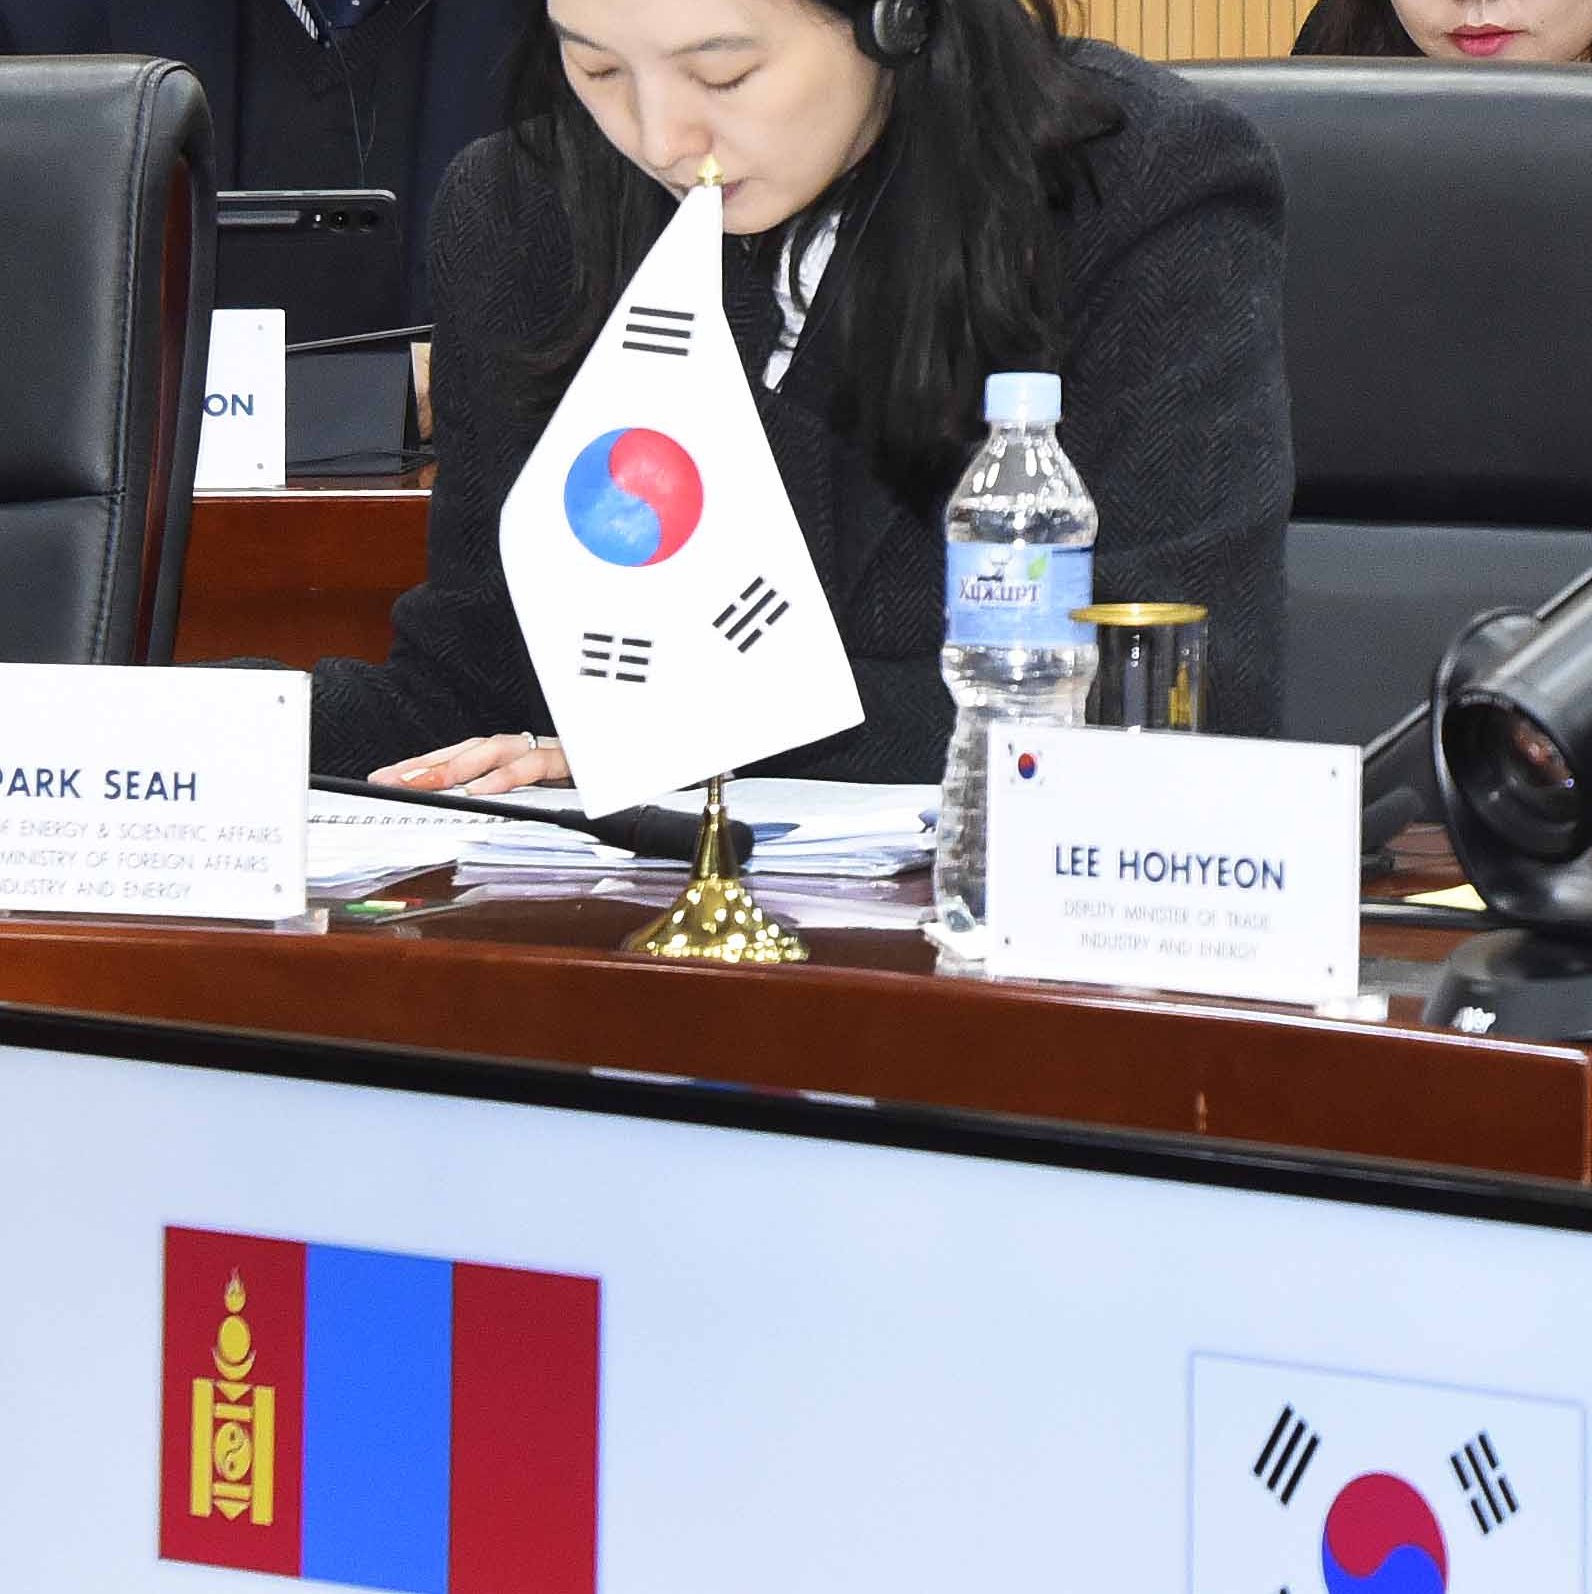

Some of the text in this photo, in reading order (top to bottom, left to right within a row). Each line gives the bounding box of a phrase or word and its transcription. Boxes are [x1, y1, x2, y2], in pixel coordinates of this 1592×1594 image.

[0, 767, 197, 802] ARK SEAH
[216, 825, 283, 845] AFFAIRS
[86, 851, 110, 869] OF
[118, 852, 194, 871] FOREIGN
[203, 854, 271, 873] AFFAIRS
[1054, 844, 1286, 892] LEE HOHYEON
[76, 879, 114, 897] AND
[123, 880, 192, 900] ENERGY
[1124, 904, 1190, 927] MINISTER
[1158, 937, 1192, 956] AND
